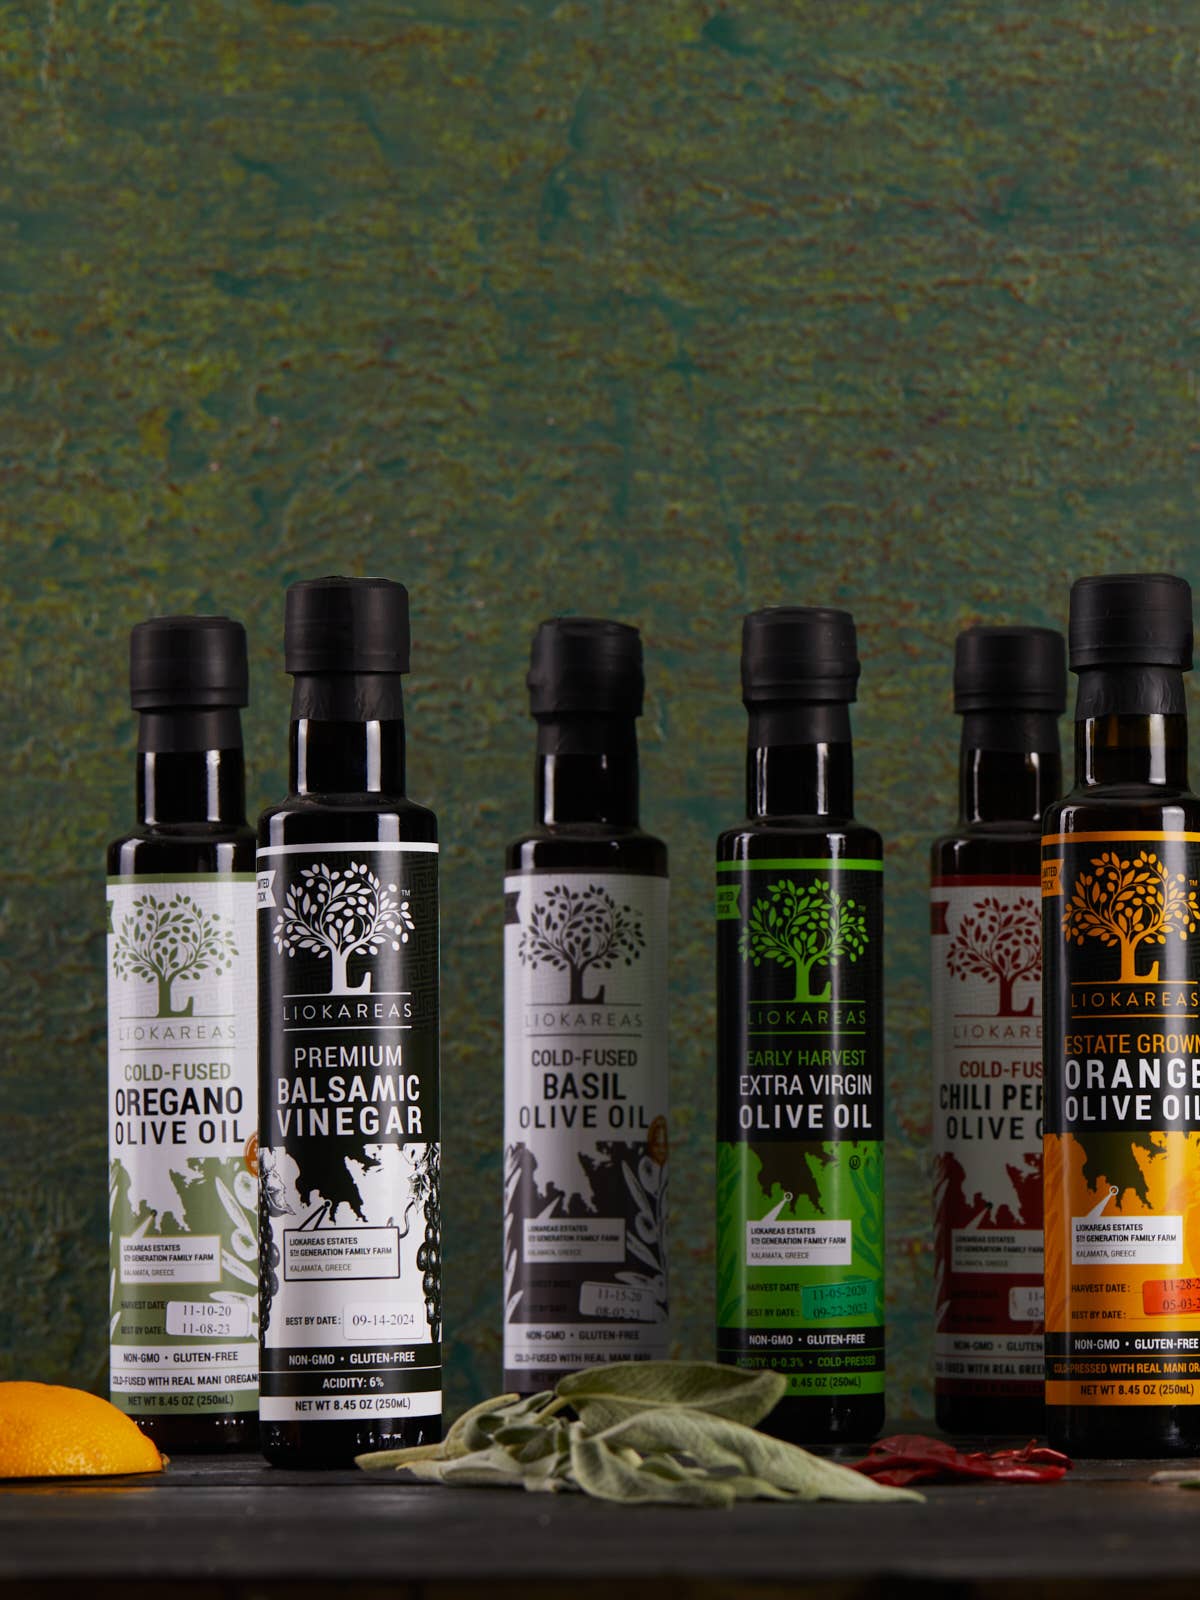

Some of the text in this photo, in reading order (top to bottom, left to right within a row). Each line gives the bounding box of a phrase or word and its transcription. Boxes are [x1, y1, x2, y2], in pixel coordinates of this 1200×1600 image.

[1072, 992, 1198, 1007] LIOKAREAS
[283, 1003, 412, 1021] LIOKAREAS
[748, 1010, 866, 1025] LIOKAREAS
[526, 1013, 642, 1028] LIOKAREAS
[119, 1025, 236, 1041] LIOKAREAS
[1064, 1034, 1130, 1054] ESTATE
[294, 1046, 402, 1068] PREMIUM
[532, 1050, 637, 1067] COLD-FUSED
[748, 1050, 866, 1066] EARLY HARVEST
[124, 1063, 231, 1081] COLD-FUSED
[278, 1074, 419, 1105] BALSAMIC
[543, 1073, 626, 1100] BASIL
[739, 1074, 872, 1096] EXTRA VIRGIN
[115, 1087, 243, 1116] OREGANO
[940, 1084, 990, 1110] CHILI
[739, 1103, 872, 1129] OLIVE OIL
[1065, 1095, 1152, 1122] OLIVE
[277, 1106, 423, 1137] VINEGAR
[519, 1105, 649, 1130] OLIVE OIL
[115, 1120, 245, 1145] OLIVE OIL
[947, 1117, 1024, 1140] OLIVE
[1087, 1234, 1128, 1242] GENERATION
[1072, 1285, 1103, 1293] HARVEST
[183, 1305, 231, 1316] 11-10-20
[1090, 1311, 1100, 1319] BY
[286, 1314, 414, 1326] BEST BY 09-14-2024
[183, 1323, 230, 1334] 11-08-23
[579, 1330, 640, 1340] GLUTEN-FREE
[749, 1334, 865, 1345] NON-GMO GLUTEN-FREE
[1075, 1338, 1199, 1349] NON-GMO GLUTEN-FREE
[123, 1352, 238, 1362] NON-GMO GLUTEN-FREE
[289, 1352, 415, 1365] NON-GMO GLUTEN-FREE
[993, 1363, 1015, 1374] REAL
[1110, 1363, 1135, 1373] WITH
[1137, 1363, 1161, 1373] REAL
[1164, 1362, 1186, 1372] MANI
[148, 1375, 222, 1386] WITH REAL MANI
[323, 1377, 384, 1388] ACIDITY: 6%
[1081, 1384, 1156, 1395] NET WT 8.45 OZ
[295, 1399, 373, 1411] NET WT 8.45 OZ
